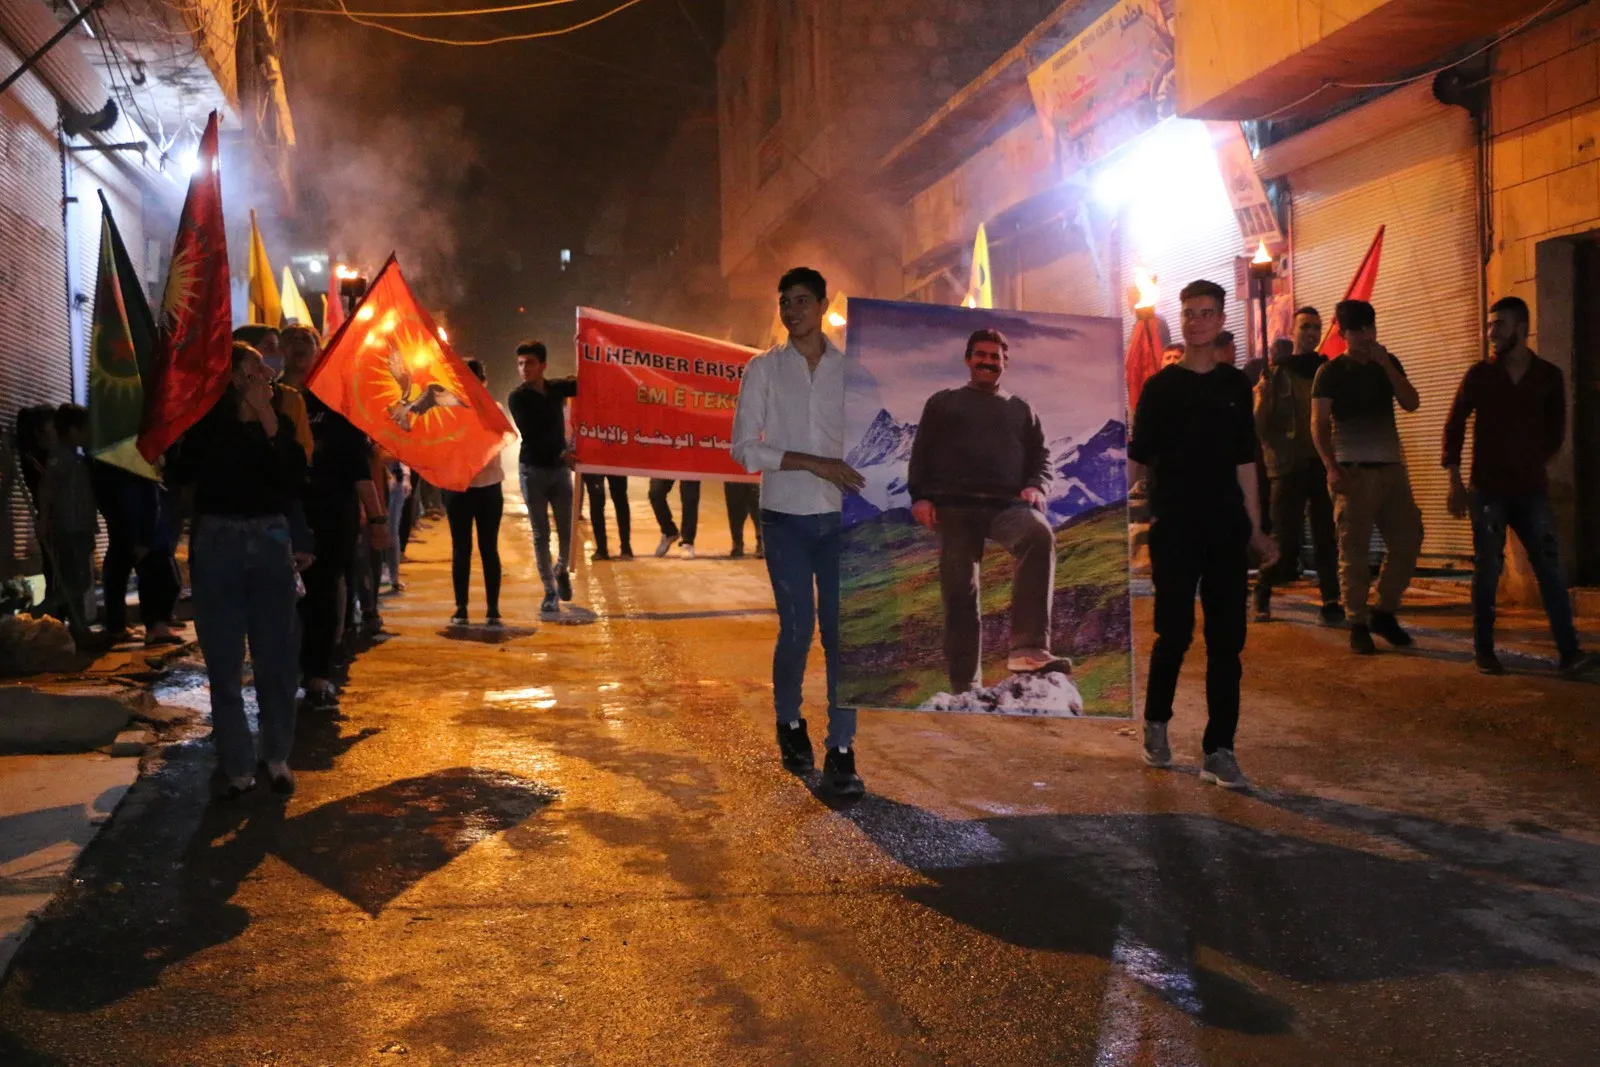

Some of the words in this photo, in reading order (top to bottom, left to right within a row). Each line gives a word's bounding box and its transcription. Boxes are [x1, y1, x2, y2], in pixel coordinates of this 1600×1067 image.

[584, 343, 600, 362] LI
[606, 347, 690, 373] HEMBER
[636, 385, 668, 406] EM
[633, 428, 694, 450] الوحشية
